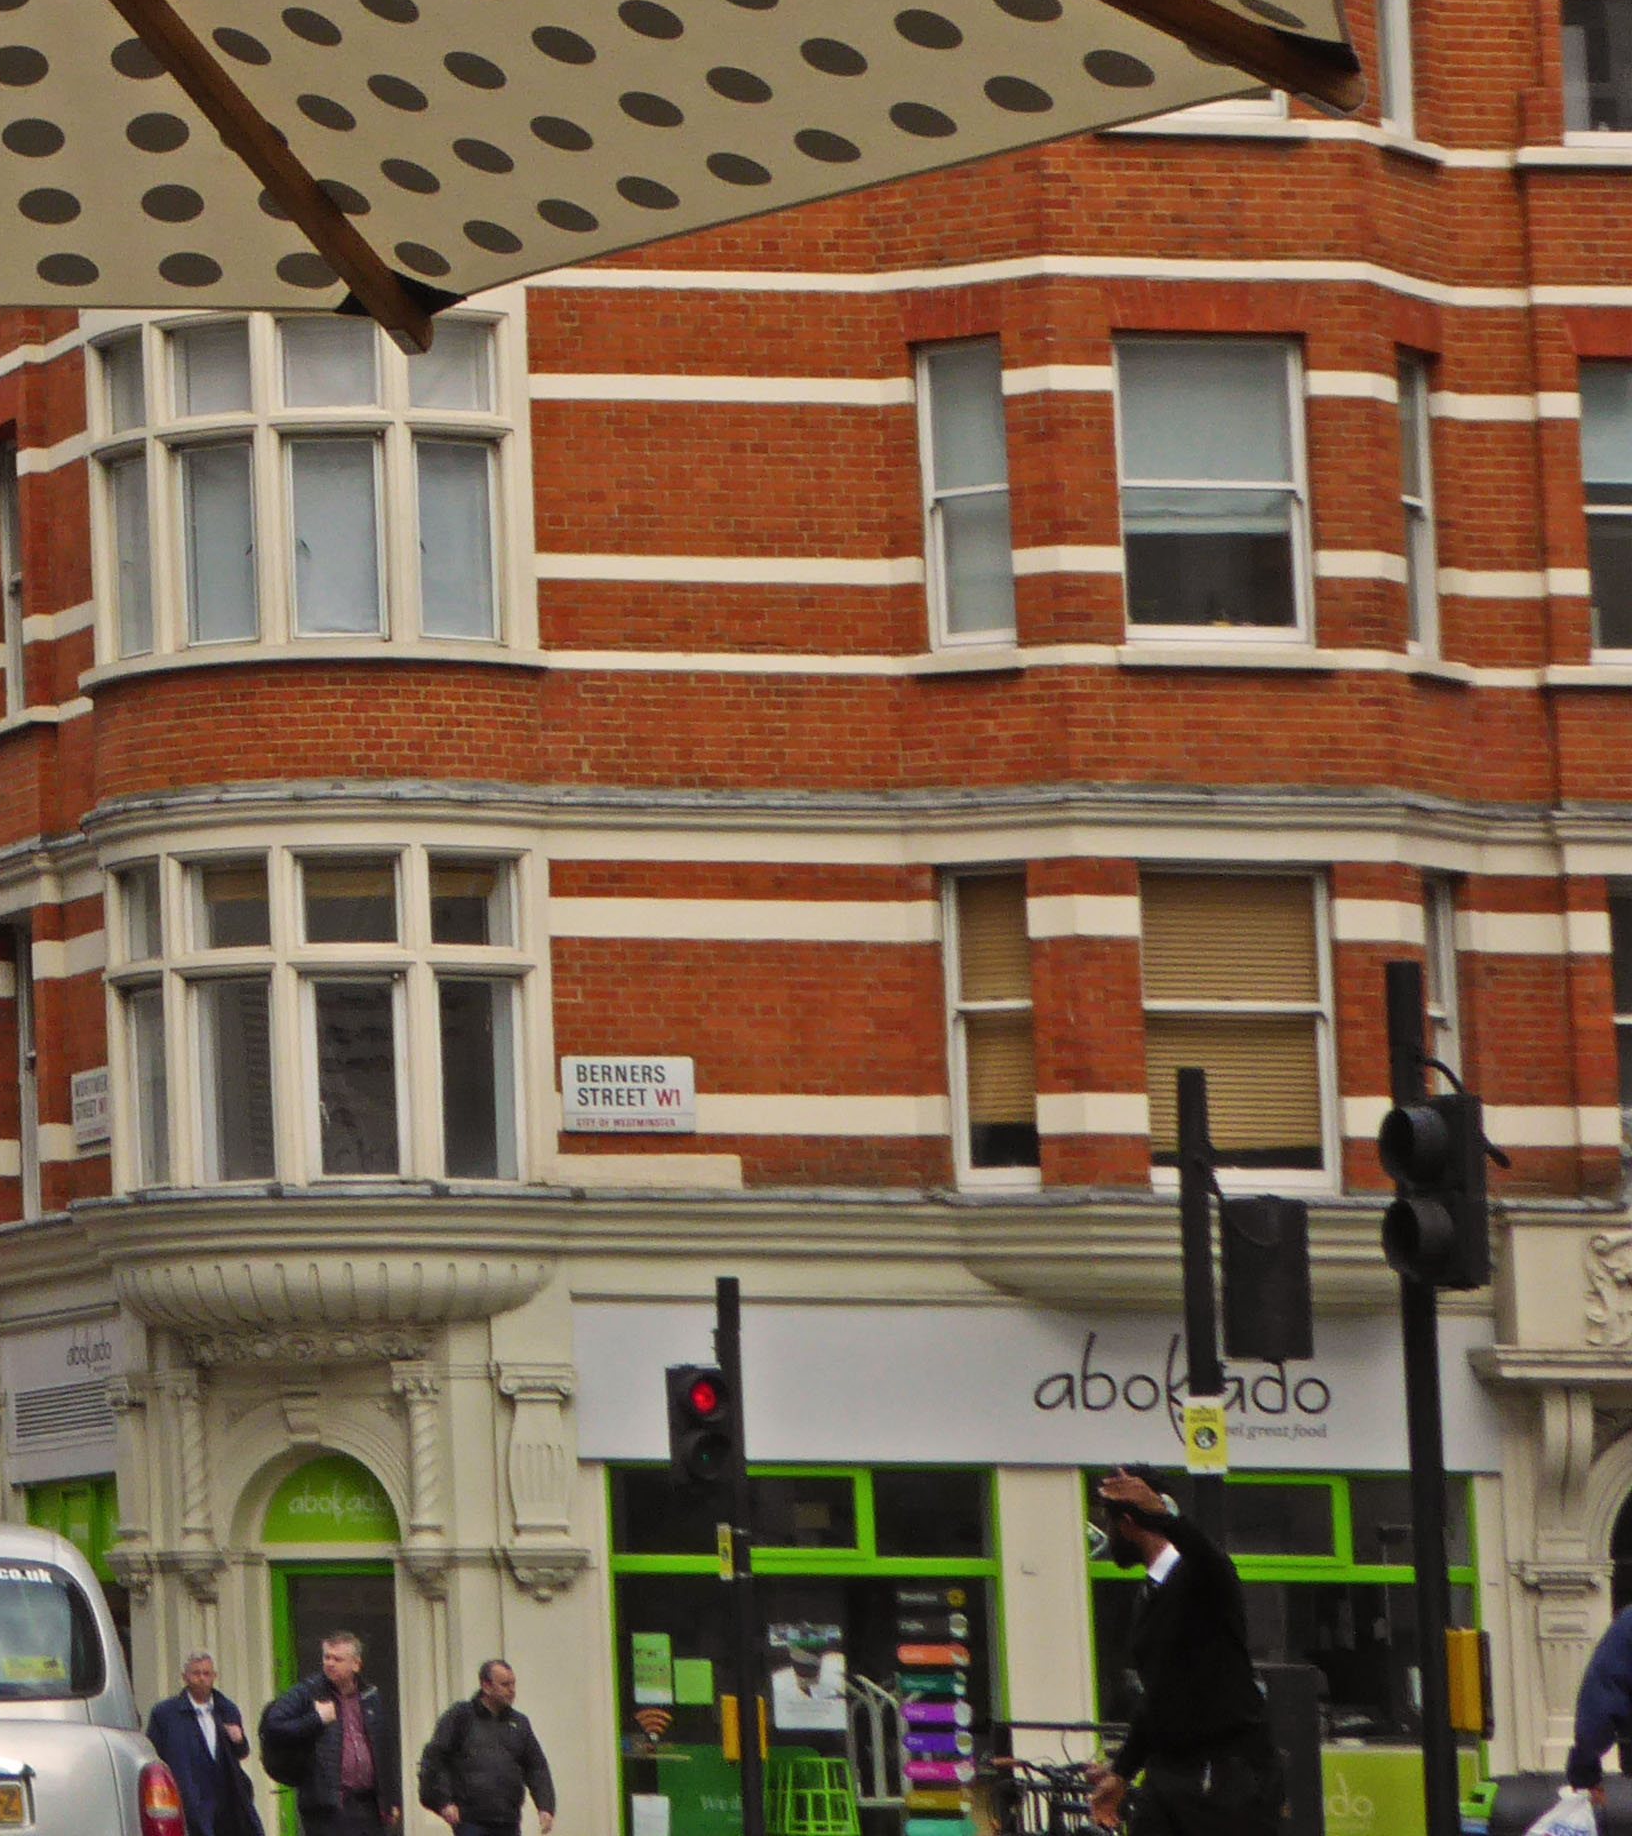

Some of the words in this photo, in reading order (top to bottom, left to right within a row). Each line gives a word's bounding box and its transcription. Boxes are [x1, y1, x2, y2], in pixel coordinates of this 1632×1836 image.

[576, 1064, 666, 1083] BERNERS
[577, 1087, 647, 1106] STREET
[655, 1088, 681, 1106] W1
